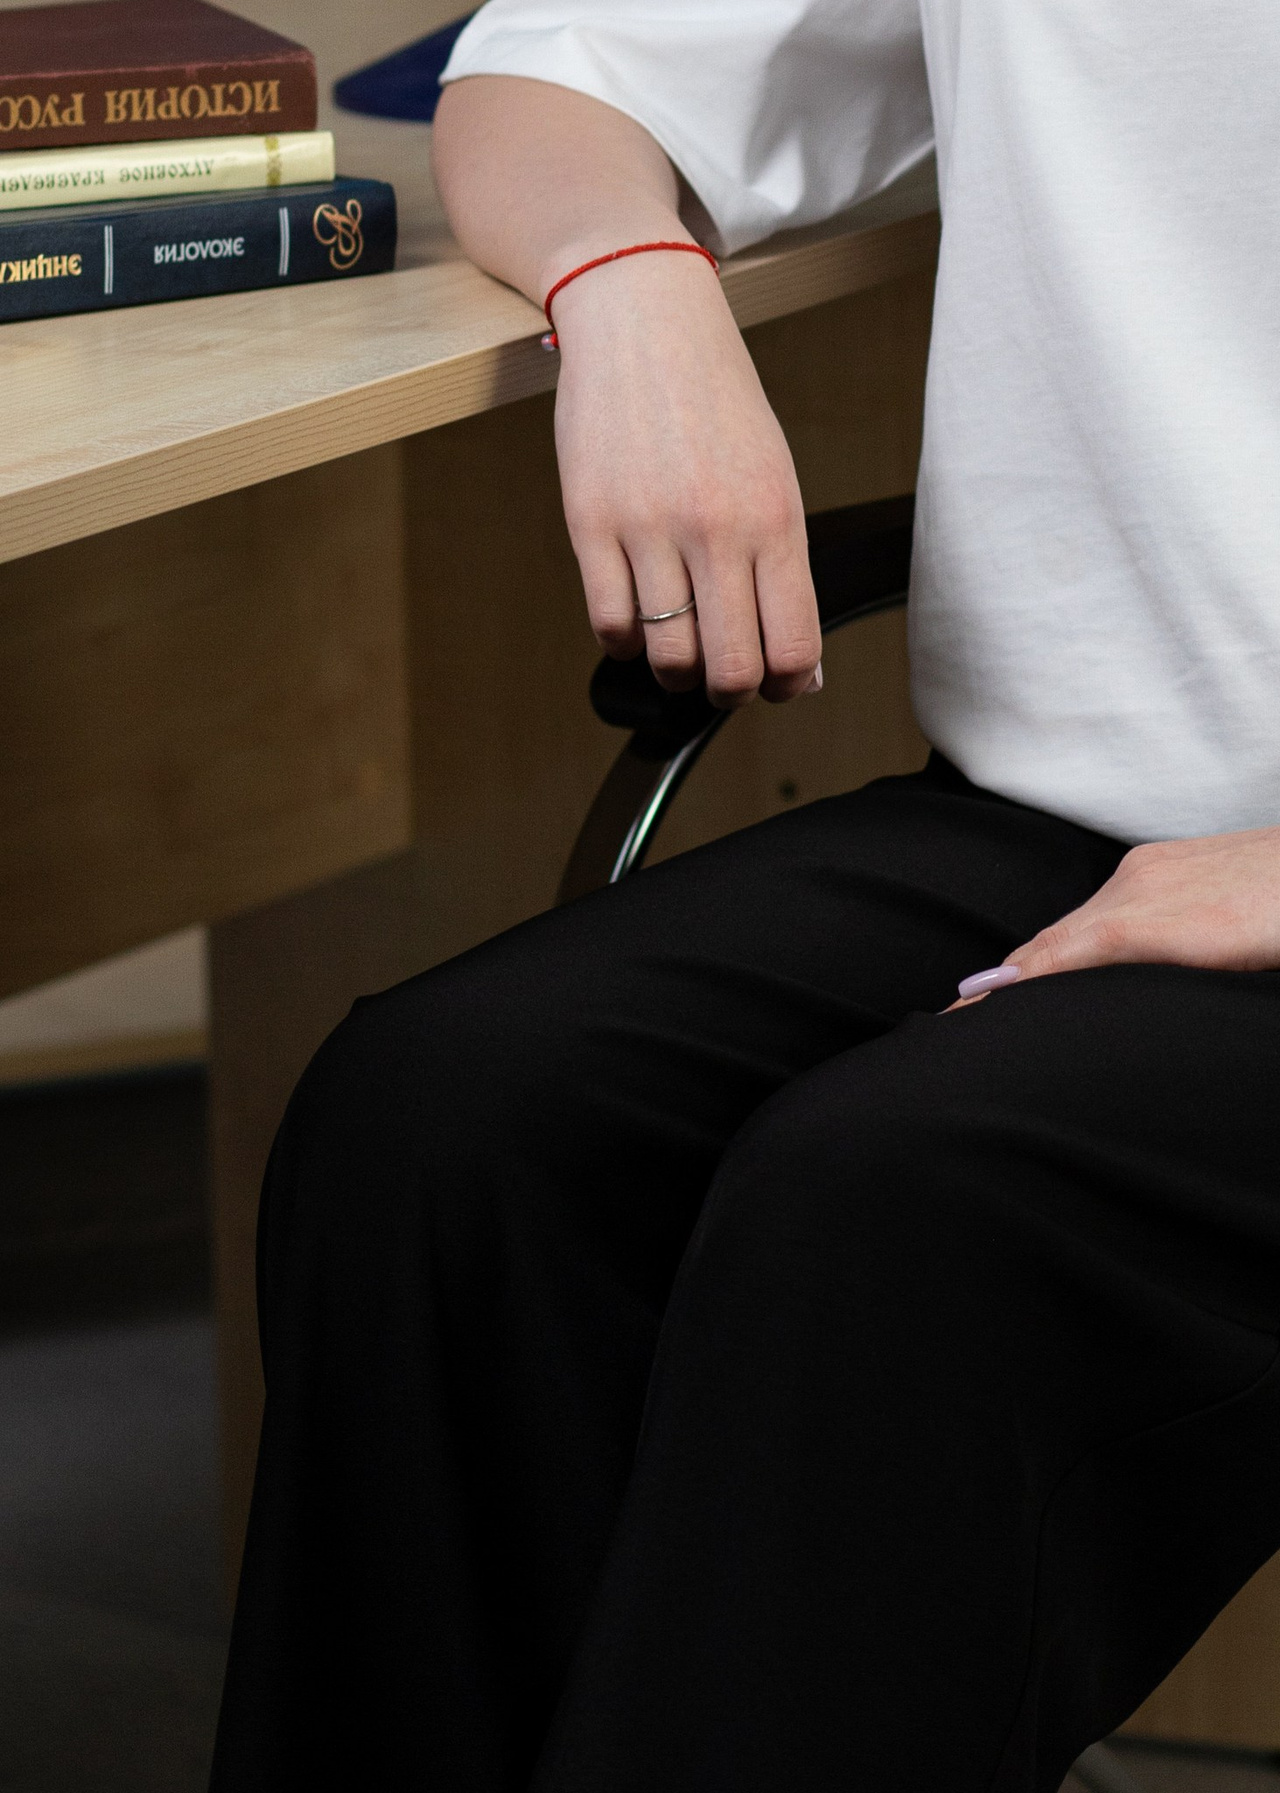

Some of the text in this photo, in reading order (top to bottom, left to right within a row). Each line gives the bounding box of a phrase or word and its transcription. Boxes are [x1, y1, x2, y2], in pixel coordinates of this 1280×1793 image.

[104, 79, 281, 125] ИСТОРИЯ
[118, 159, 215, 184] ДУХОВНОЕ
[153, 235, 246, 265] ЭКОЛОГИЯ
